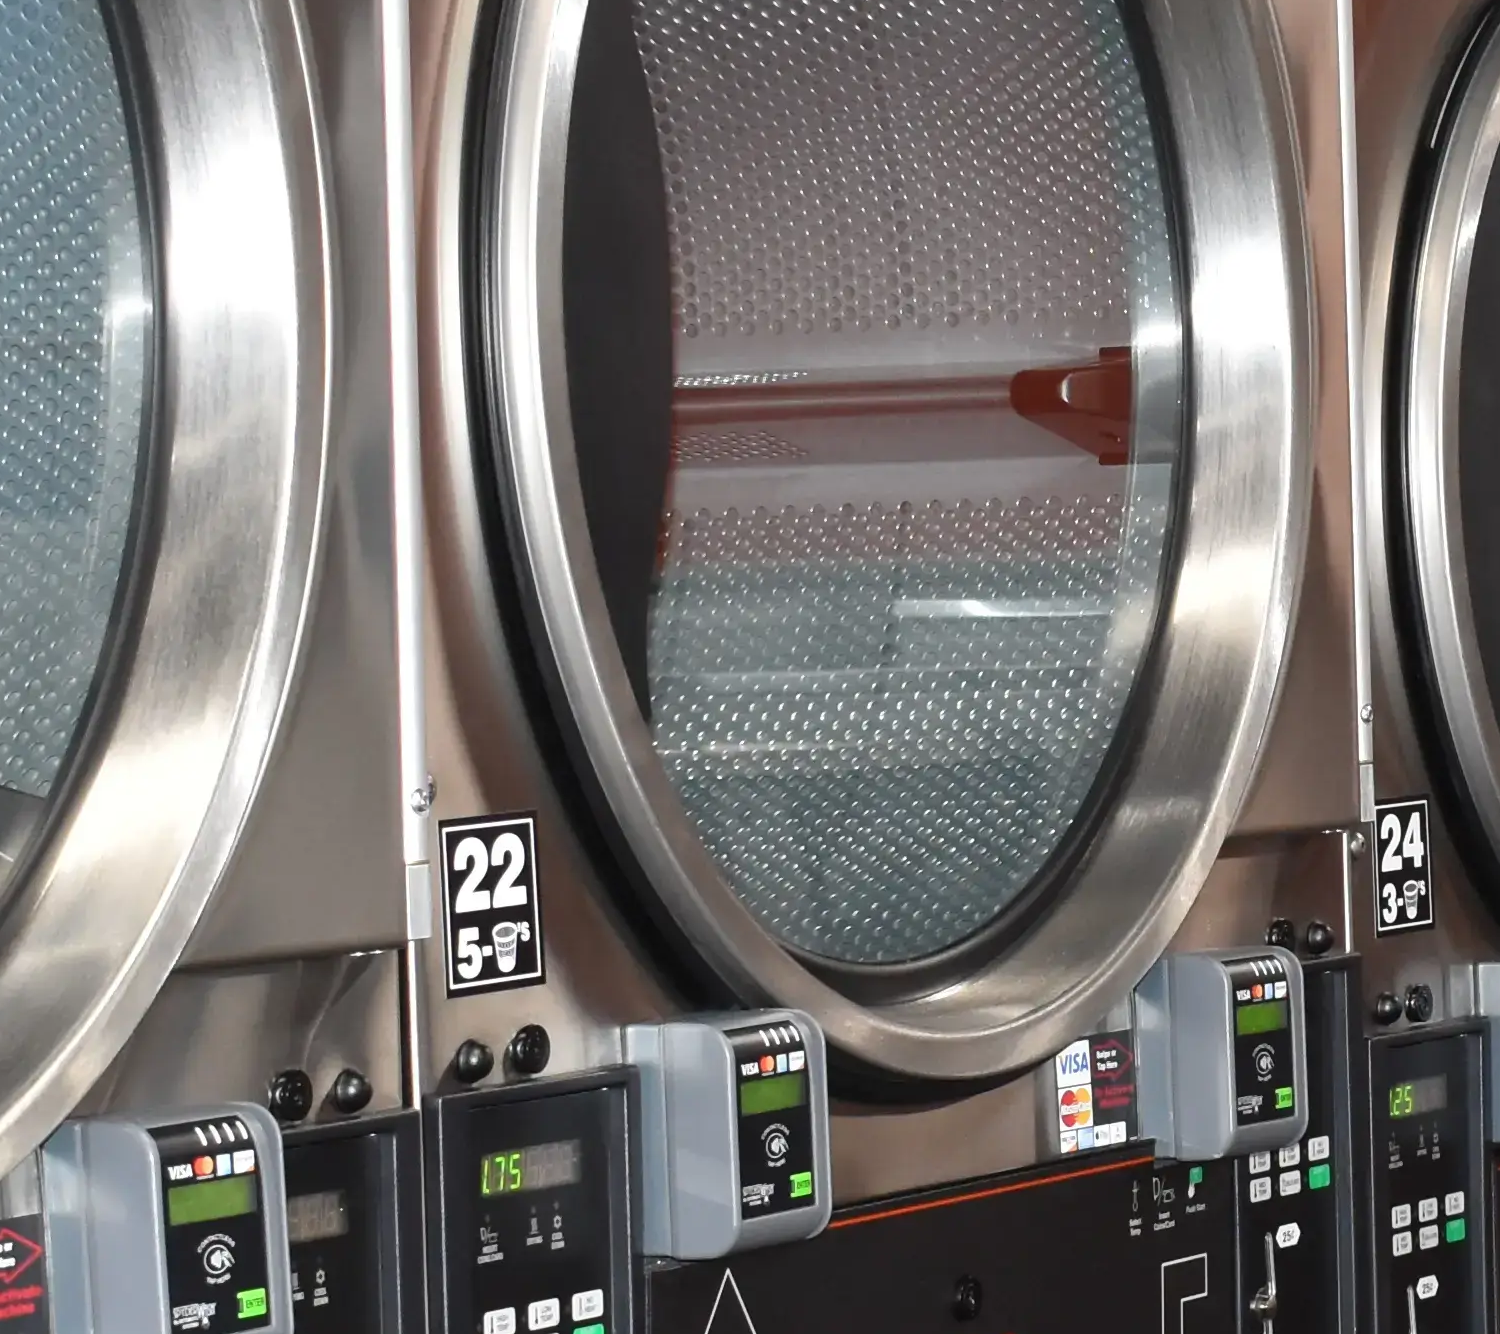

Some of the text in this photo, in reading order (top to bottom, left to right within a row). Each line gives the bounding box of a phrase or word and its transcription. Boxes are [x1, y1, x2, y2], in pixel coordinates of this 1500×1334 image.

[1380, 811, 1425, 872] 24
[453, 832, 528, 914] 22
[741, 1062, 759, 1076] VISA
[1060, 1052, 1089, 1075] VISA
[167, 1163, 194, 1181] VISA
[245, 1296, 265, 1309] ENTER
